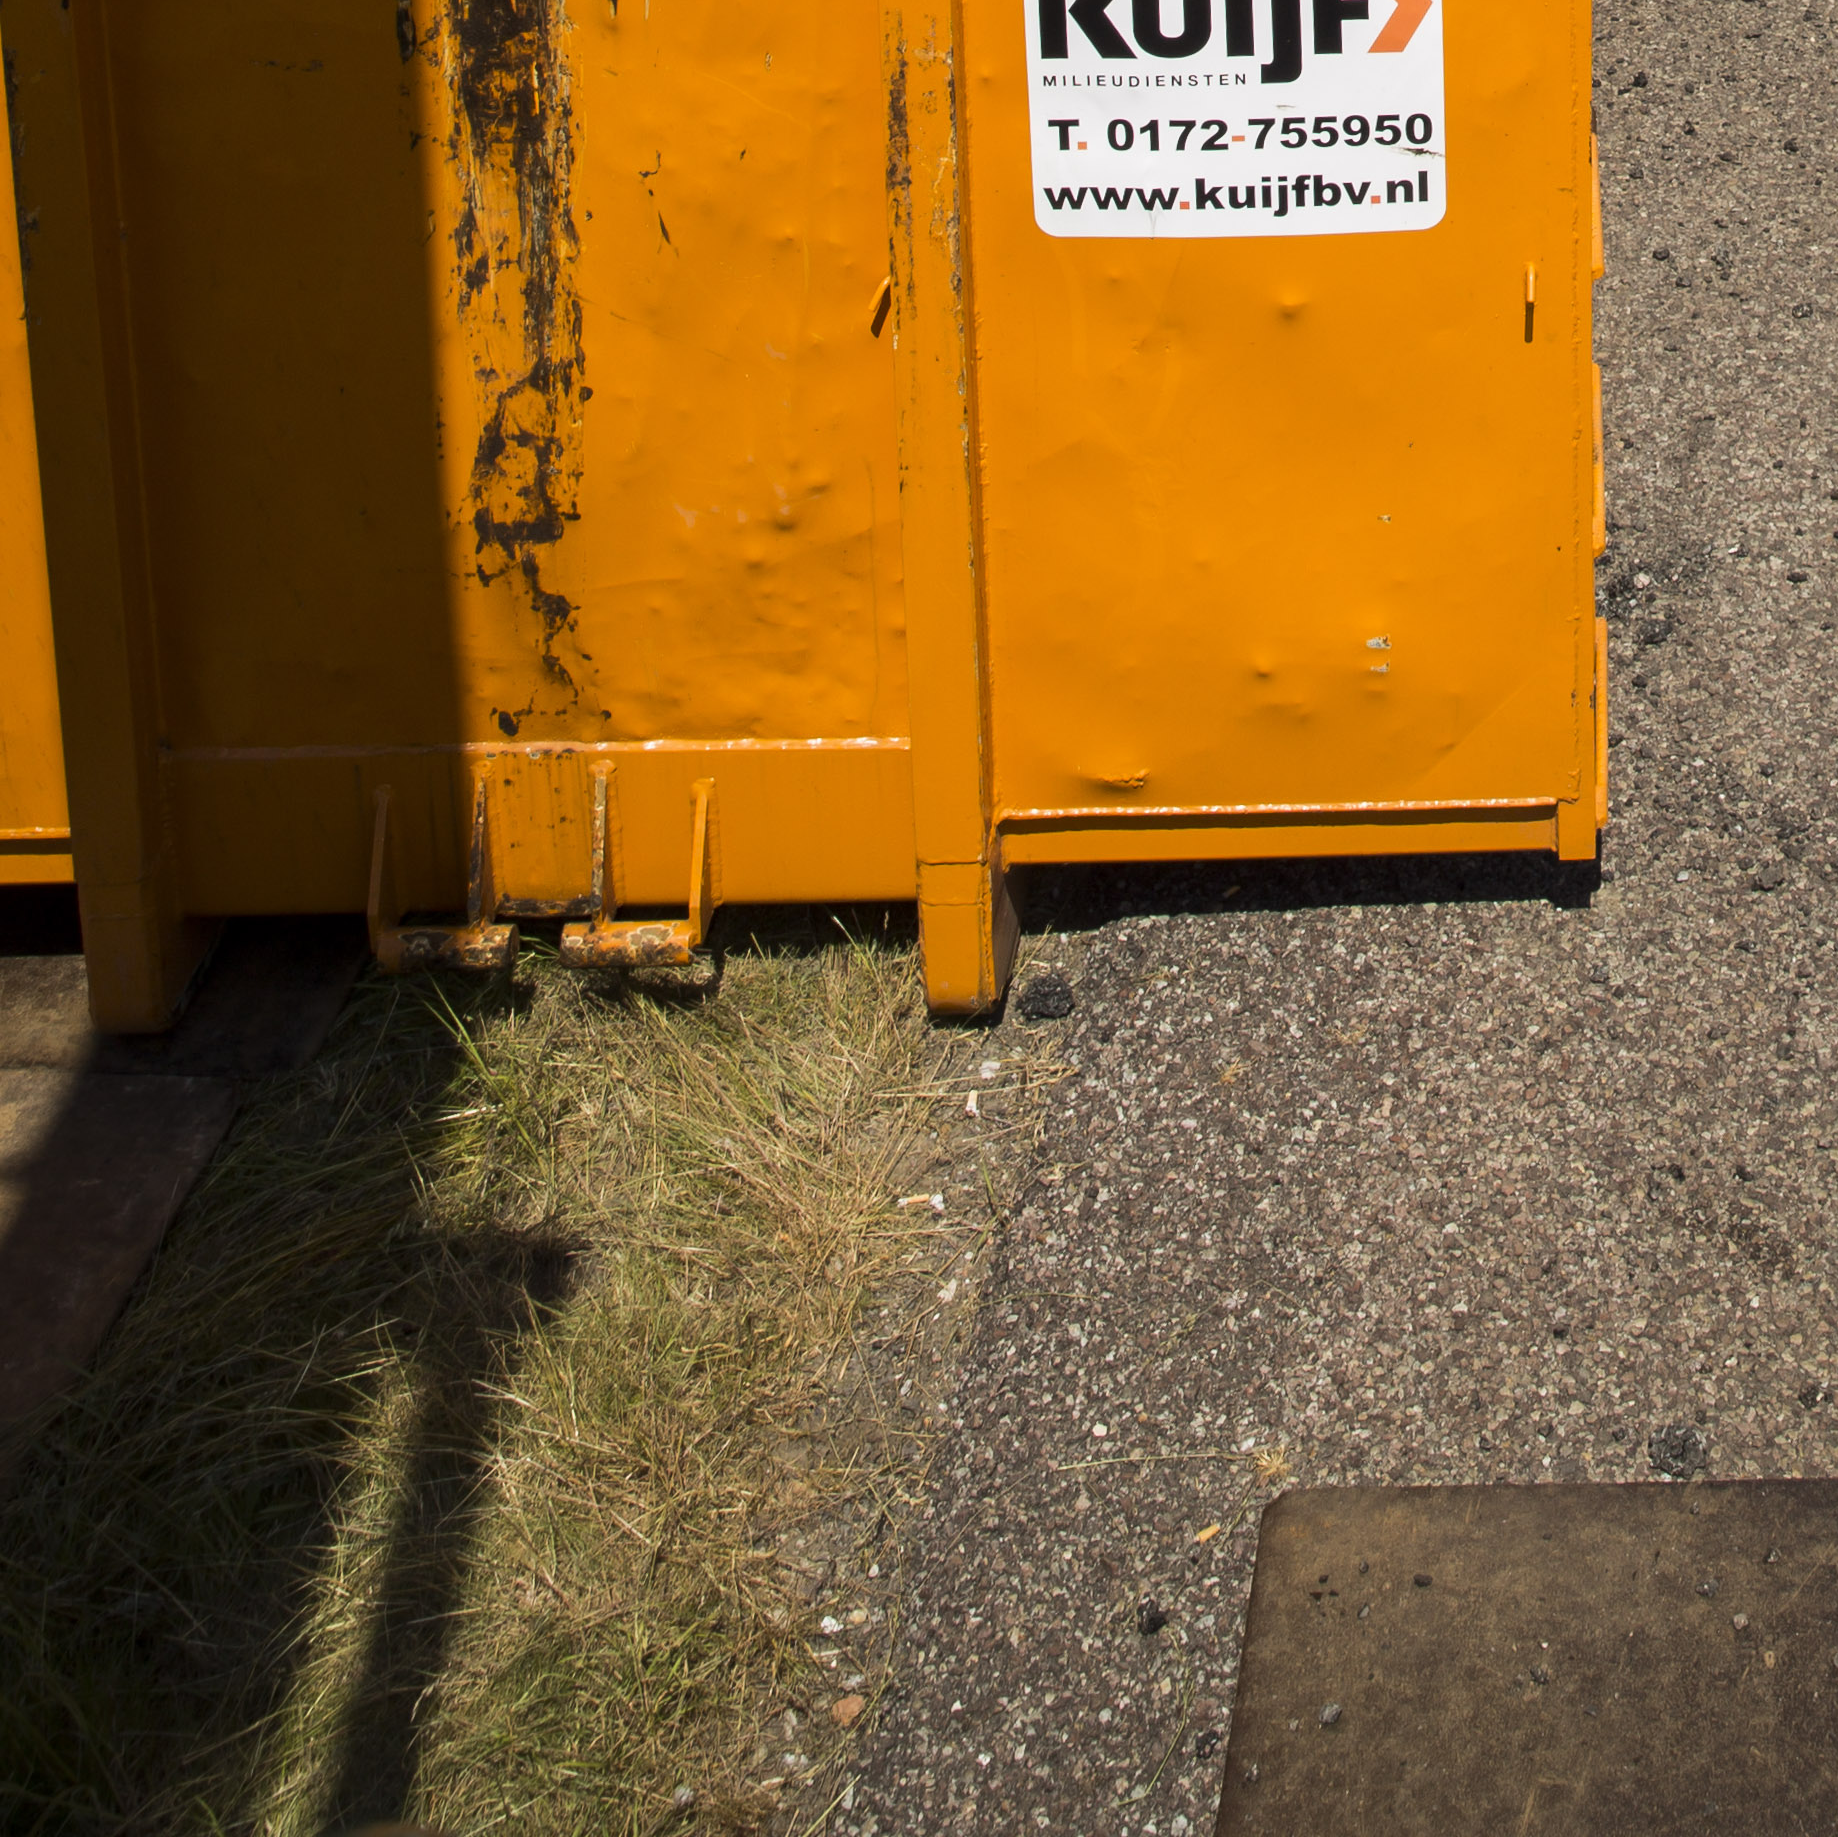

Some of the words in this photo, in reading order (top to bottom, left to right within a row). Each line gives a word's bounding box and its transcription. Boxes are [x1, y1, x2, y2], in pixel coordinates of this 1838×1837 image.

[1042, 73, 1247, 88] MILIEUDIENSTEN
[1047, 118, 1088, 151] T.
[1106, 112, 1433, 152] 0172-755950
[1044, 170, 1429, 217] www.kuijfbv.nl
